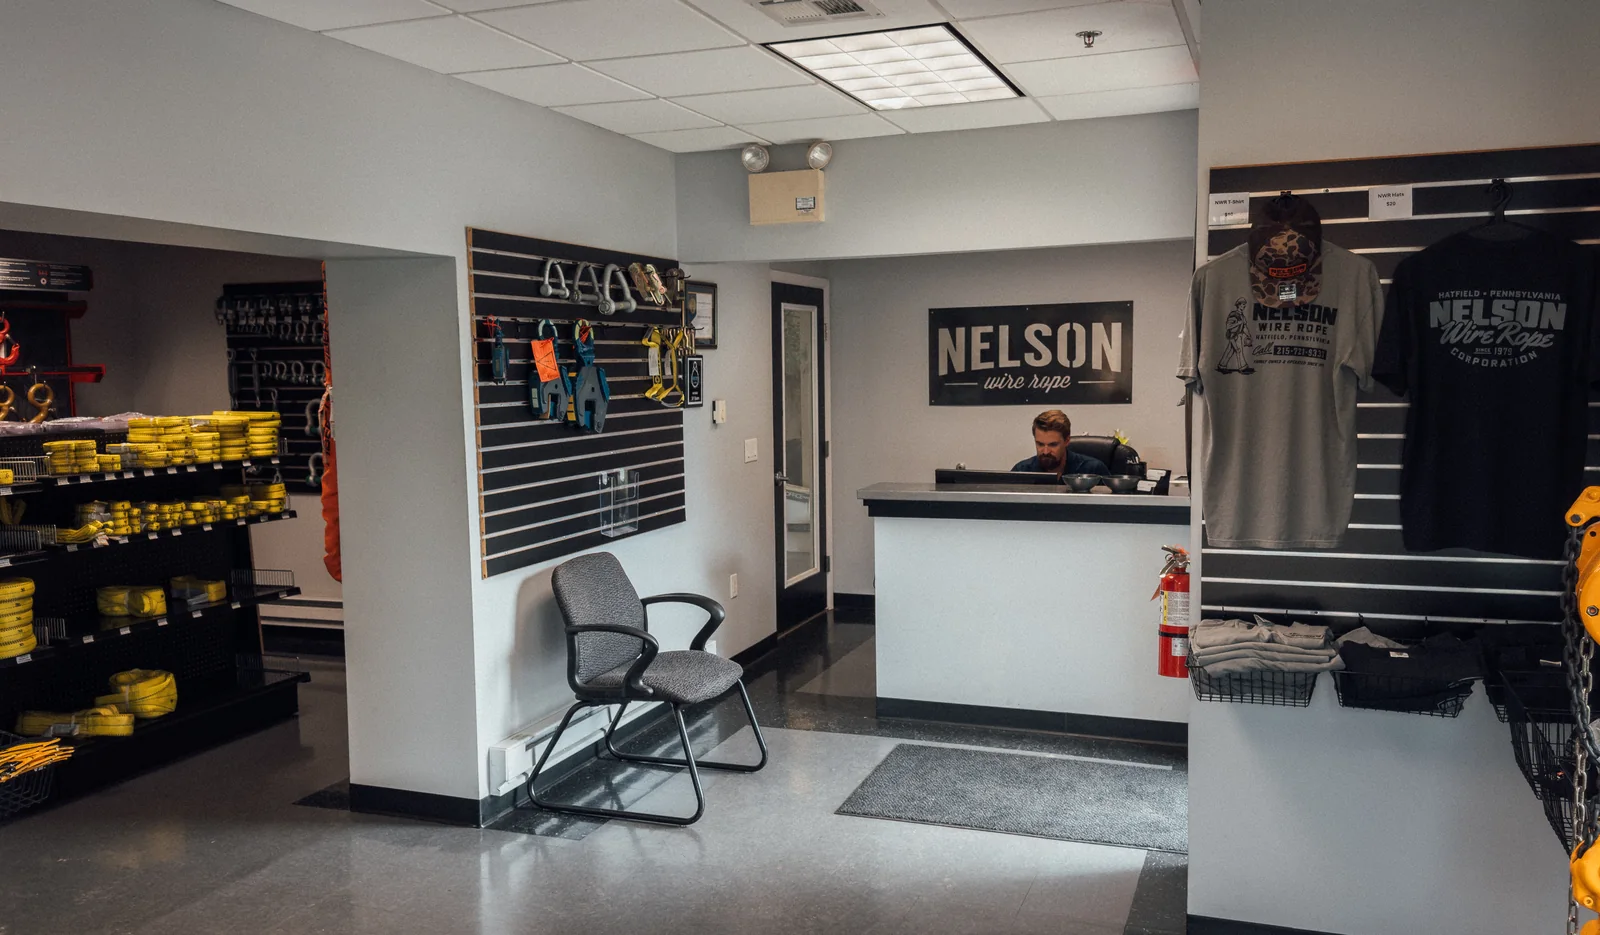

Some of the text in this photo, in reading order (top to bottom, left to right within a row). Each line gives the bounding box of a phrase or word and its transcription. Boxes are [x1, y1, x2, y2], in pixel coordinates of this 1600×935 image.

[1438, 290, 1561, 300] HATFIELD PENNSYLVANIA
[1252, 303, 1338, 326] NELSON
[1429, 299, 1567, 330] NELSON
[1258, 322, 1328, 336] WIRE ROPE
[1440, 320, 1555, 352] Wire Rope
[938, 322, 1122, 376] NELSON
[1252, 341, 1274, 356] Call
[1450, 347, 1537, 368] CORPORATION
[984, 373, 1071, 393] wire rope
